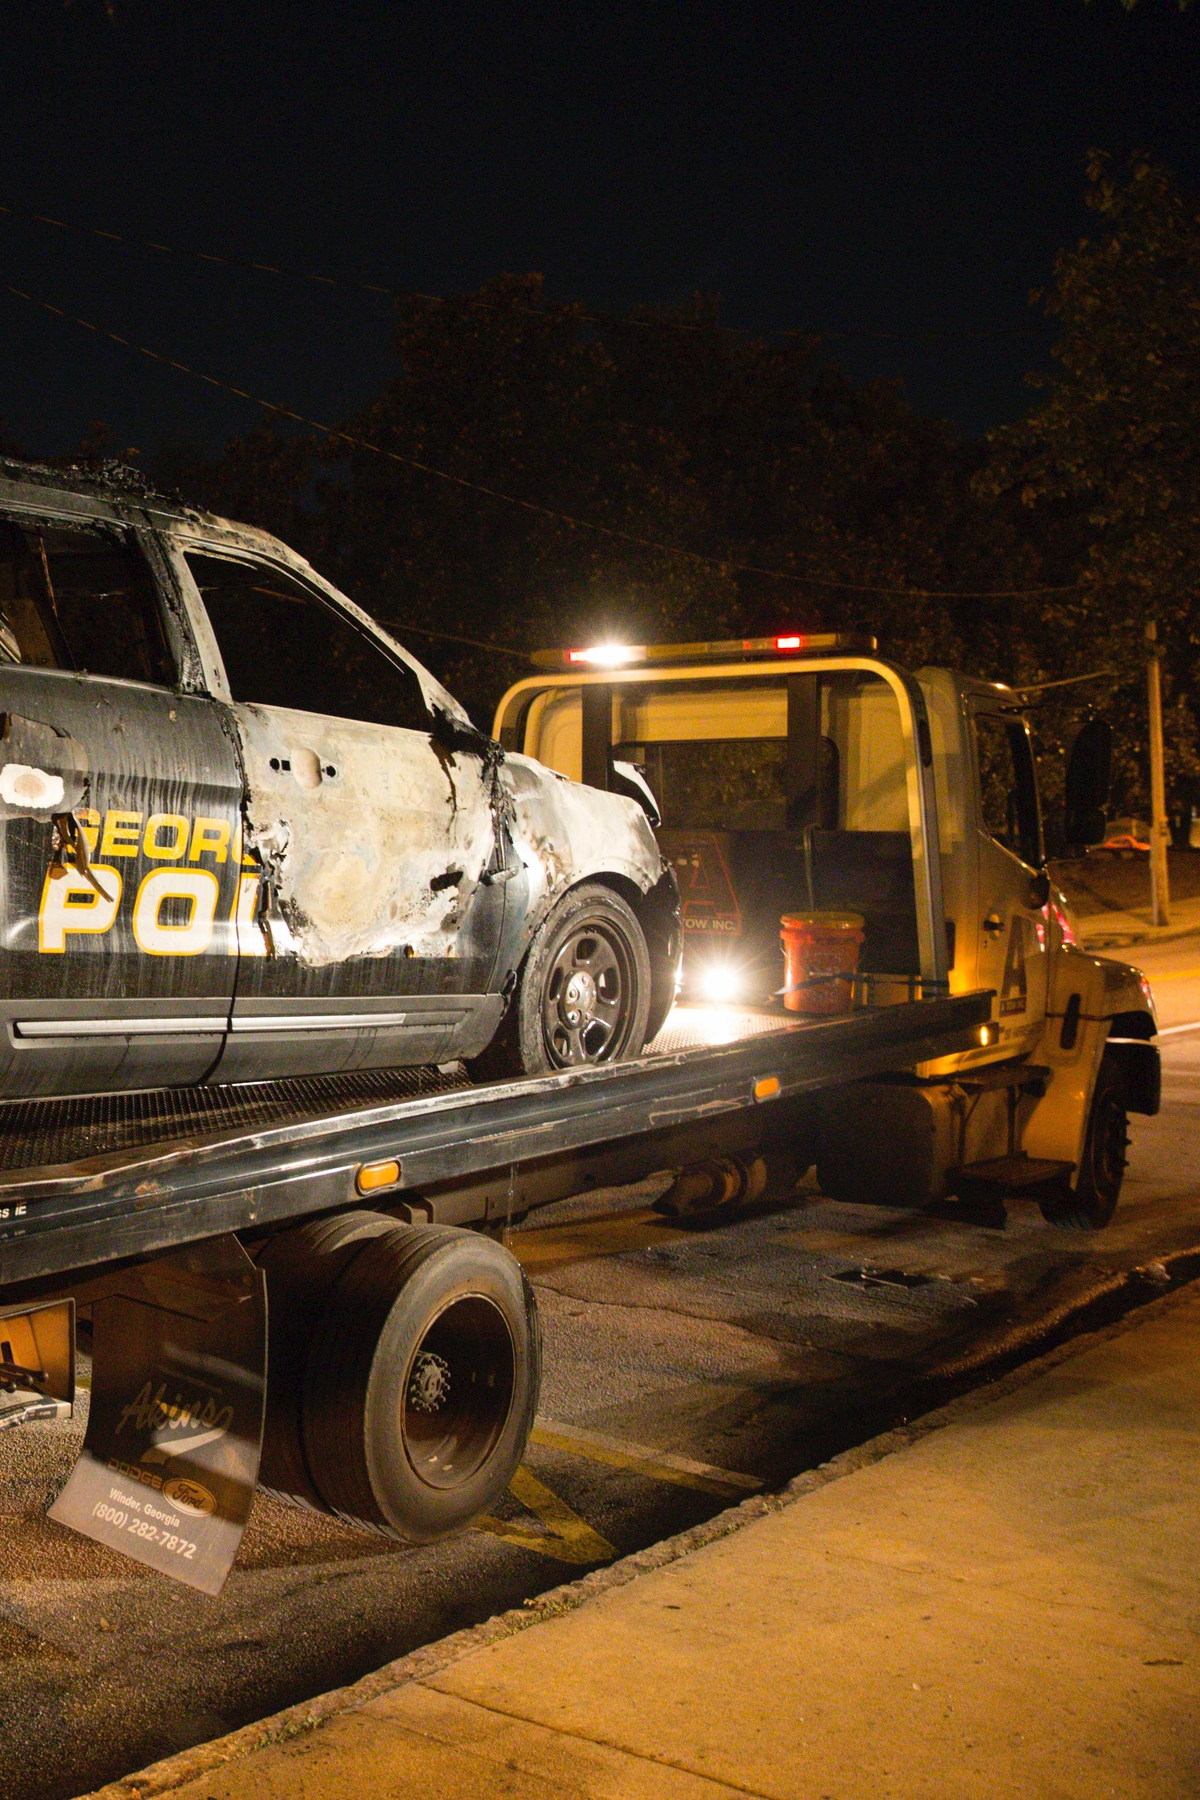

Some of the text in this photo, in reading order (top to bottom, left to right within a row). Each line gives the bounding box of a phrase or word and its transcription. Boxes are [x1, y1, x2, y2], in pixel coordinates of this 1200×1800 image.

[107, 1458, 163, 1490] DODGE
[109, 1487, 180, 1528] Winder, Georgia
[92, 1501, 198, 1560] (800) 282-7872
